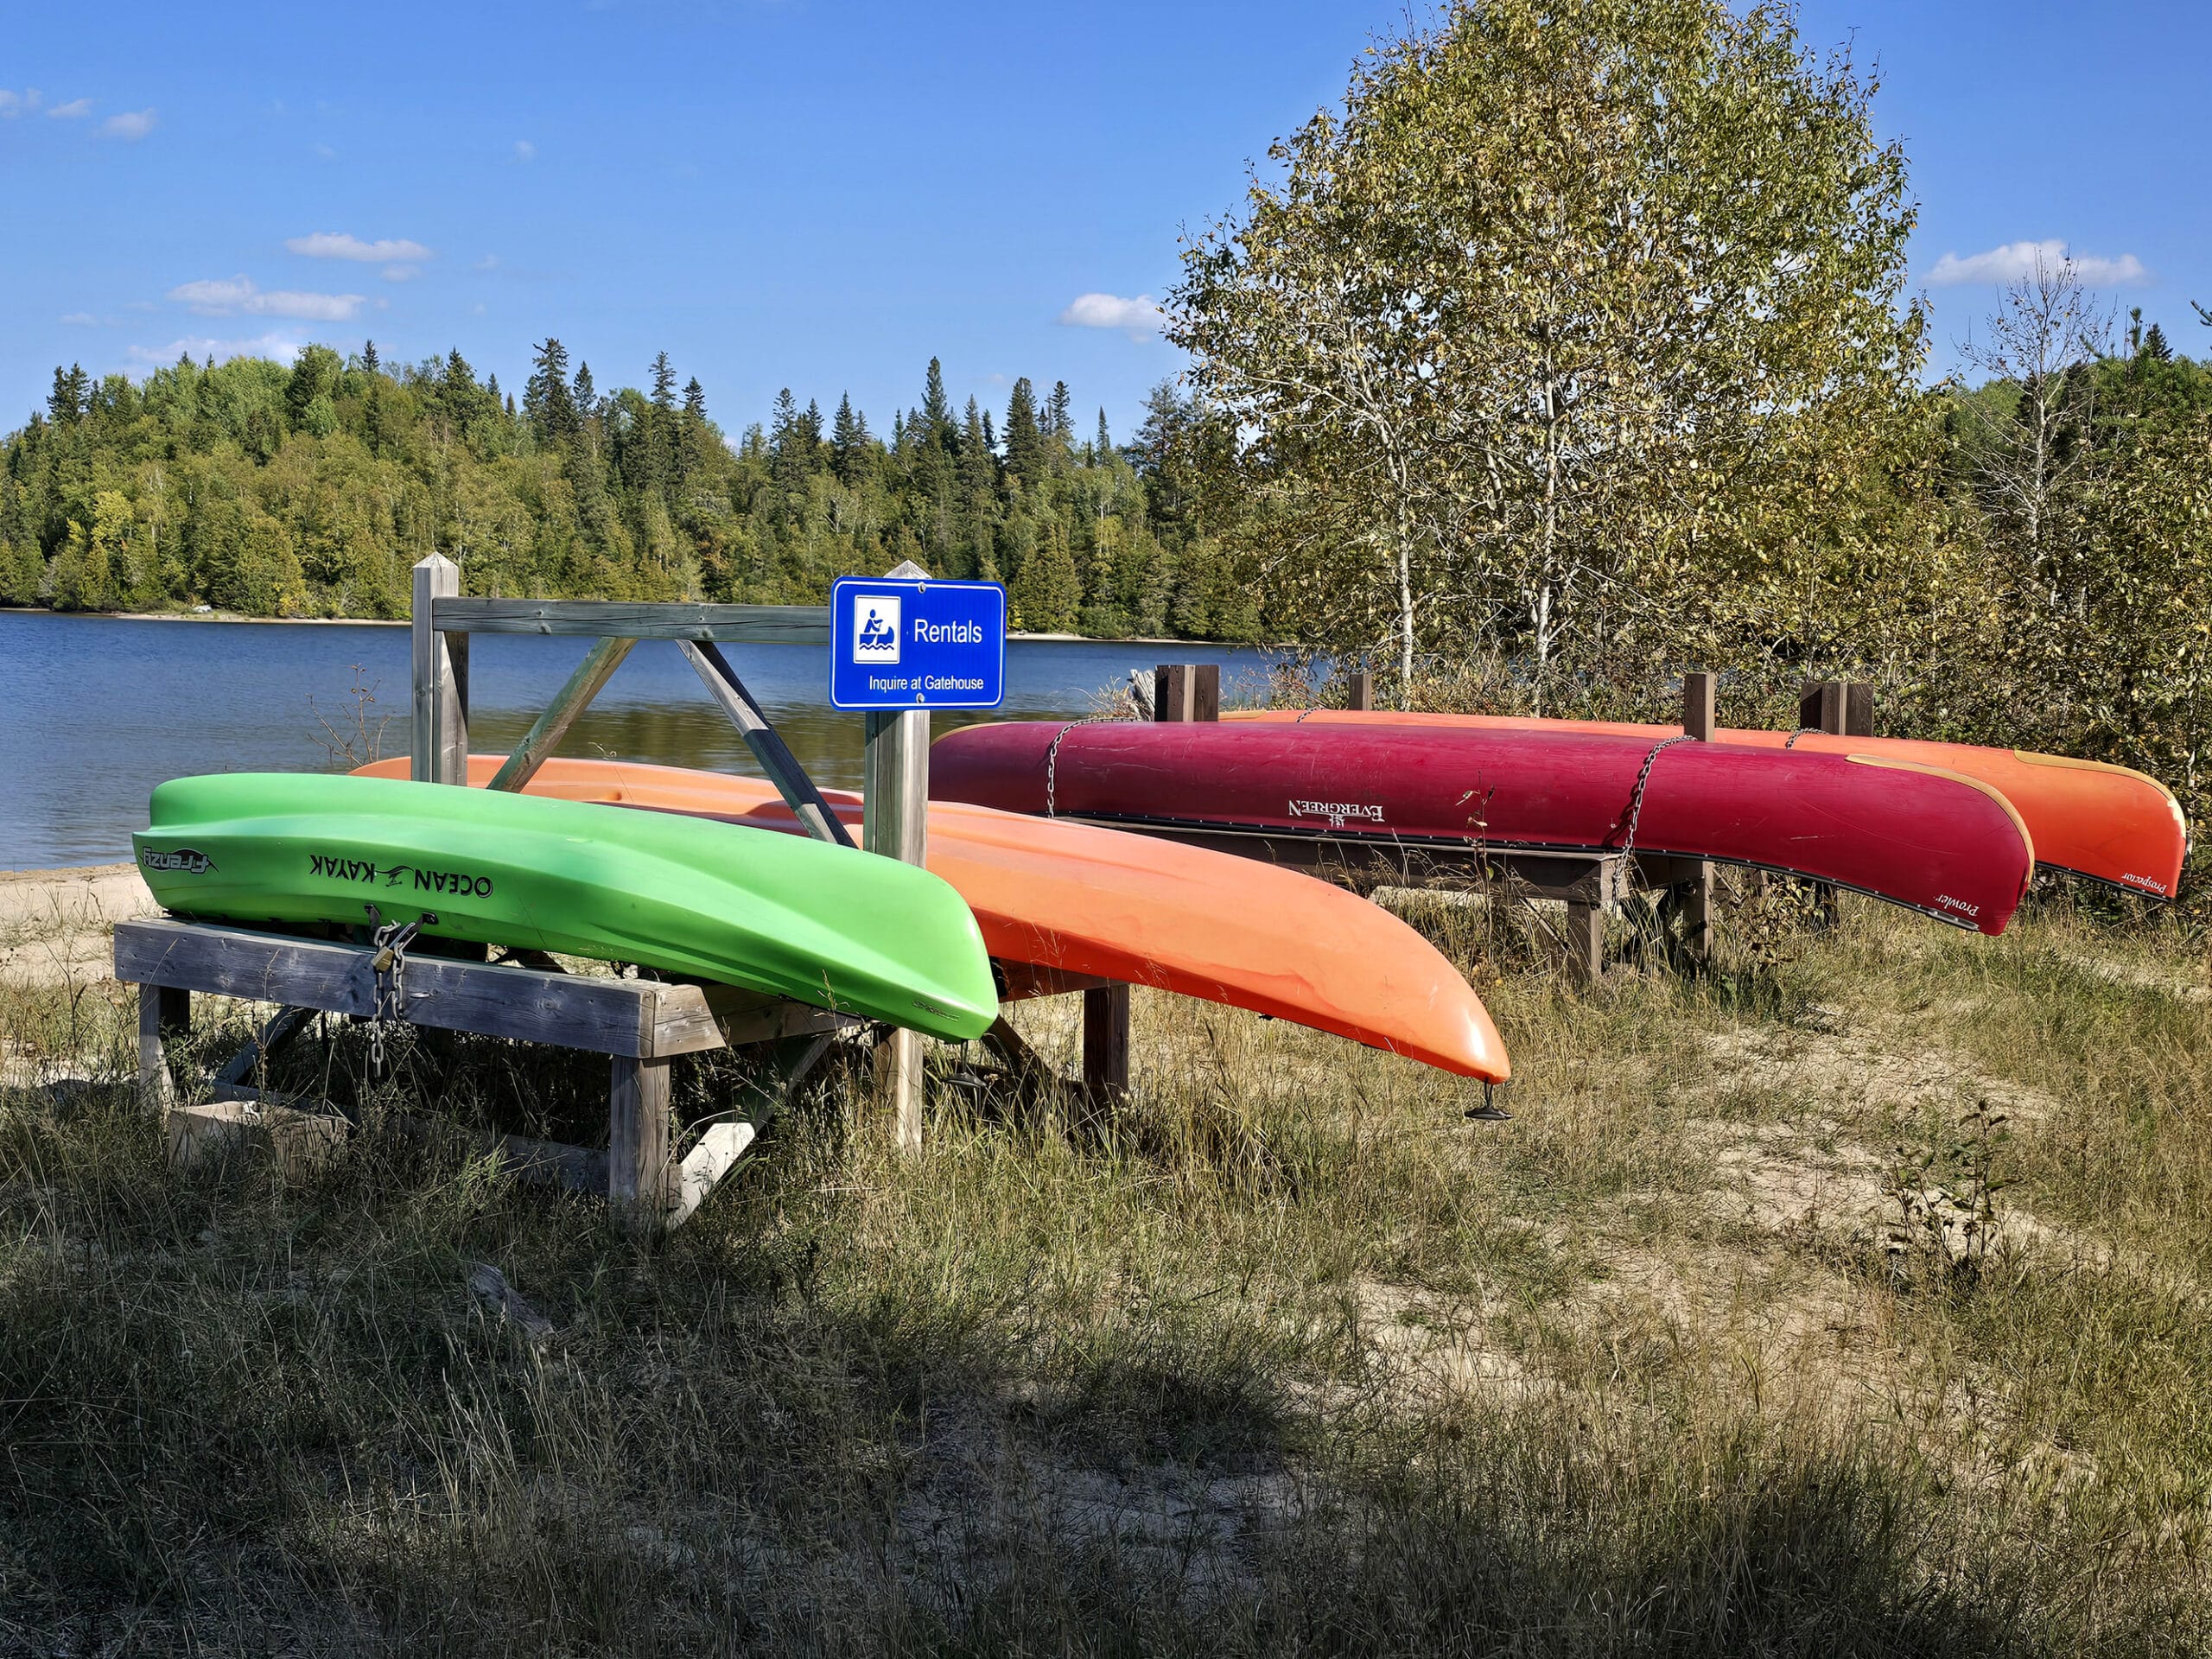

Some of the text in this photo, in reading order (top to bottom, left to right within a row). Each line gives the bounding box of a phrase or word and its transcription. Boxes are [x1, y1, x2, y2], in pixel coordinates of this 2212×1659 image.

[914, 619, 982, 643] Rentals
[869, 675, 984, 693] Inquire at Gatehouse
[1288, 800, 1385, 822] EVERGREEN
[309, 854, 493, 898] OCEAN KAYAK
[2121, 873, 2167, 893] Prospector
[1936, 894, 1980, 916] Prowler
